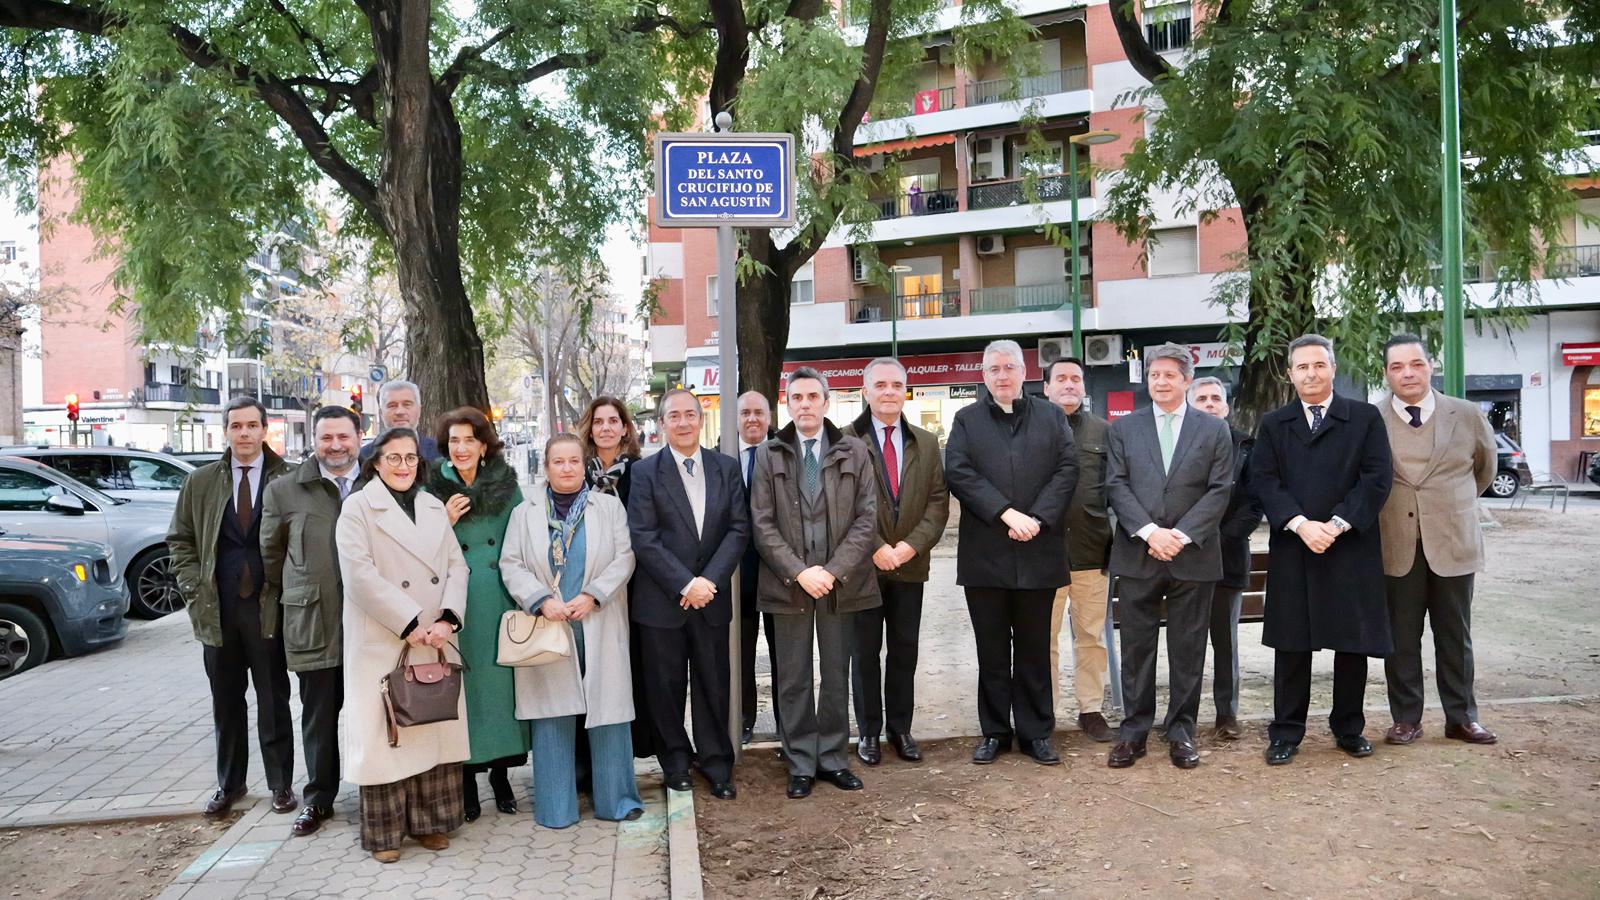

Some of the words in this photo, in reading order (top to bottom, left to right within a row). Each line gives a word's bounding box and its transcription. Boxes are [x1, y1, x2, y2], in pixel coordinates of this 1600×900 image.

[697, 151, 752, 164] PLAZA
[688, 169, 715, 179] DEL
[718, 169, 763, 179] SANTO
[677, 183, 753, 193] CRUCIFIJO
[755, 183, 773, 193] DE
[680, 196, 707, 207] SAN
[710, 194, 771, 207] AGUSTÍN
[823, 369, 864, 377] RECAMBIO
[907, 365, 948, 374] ALQUILER
